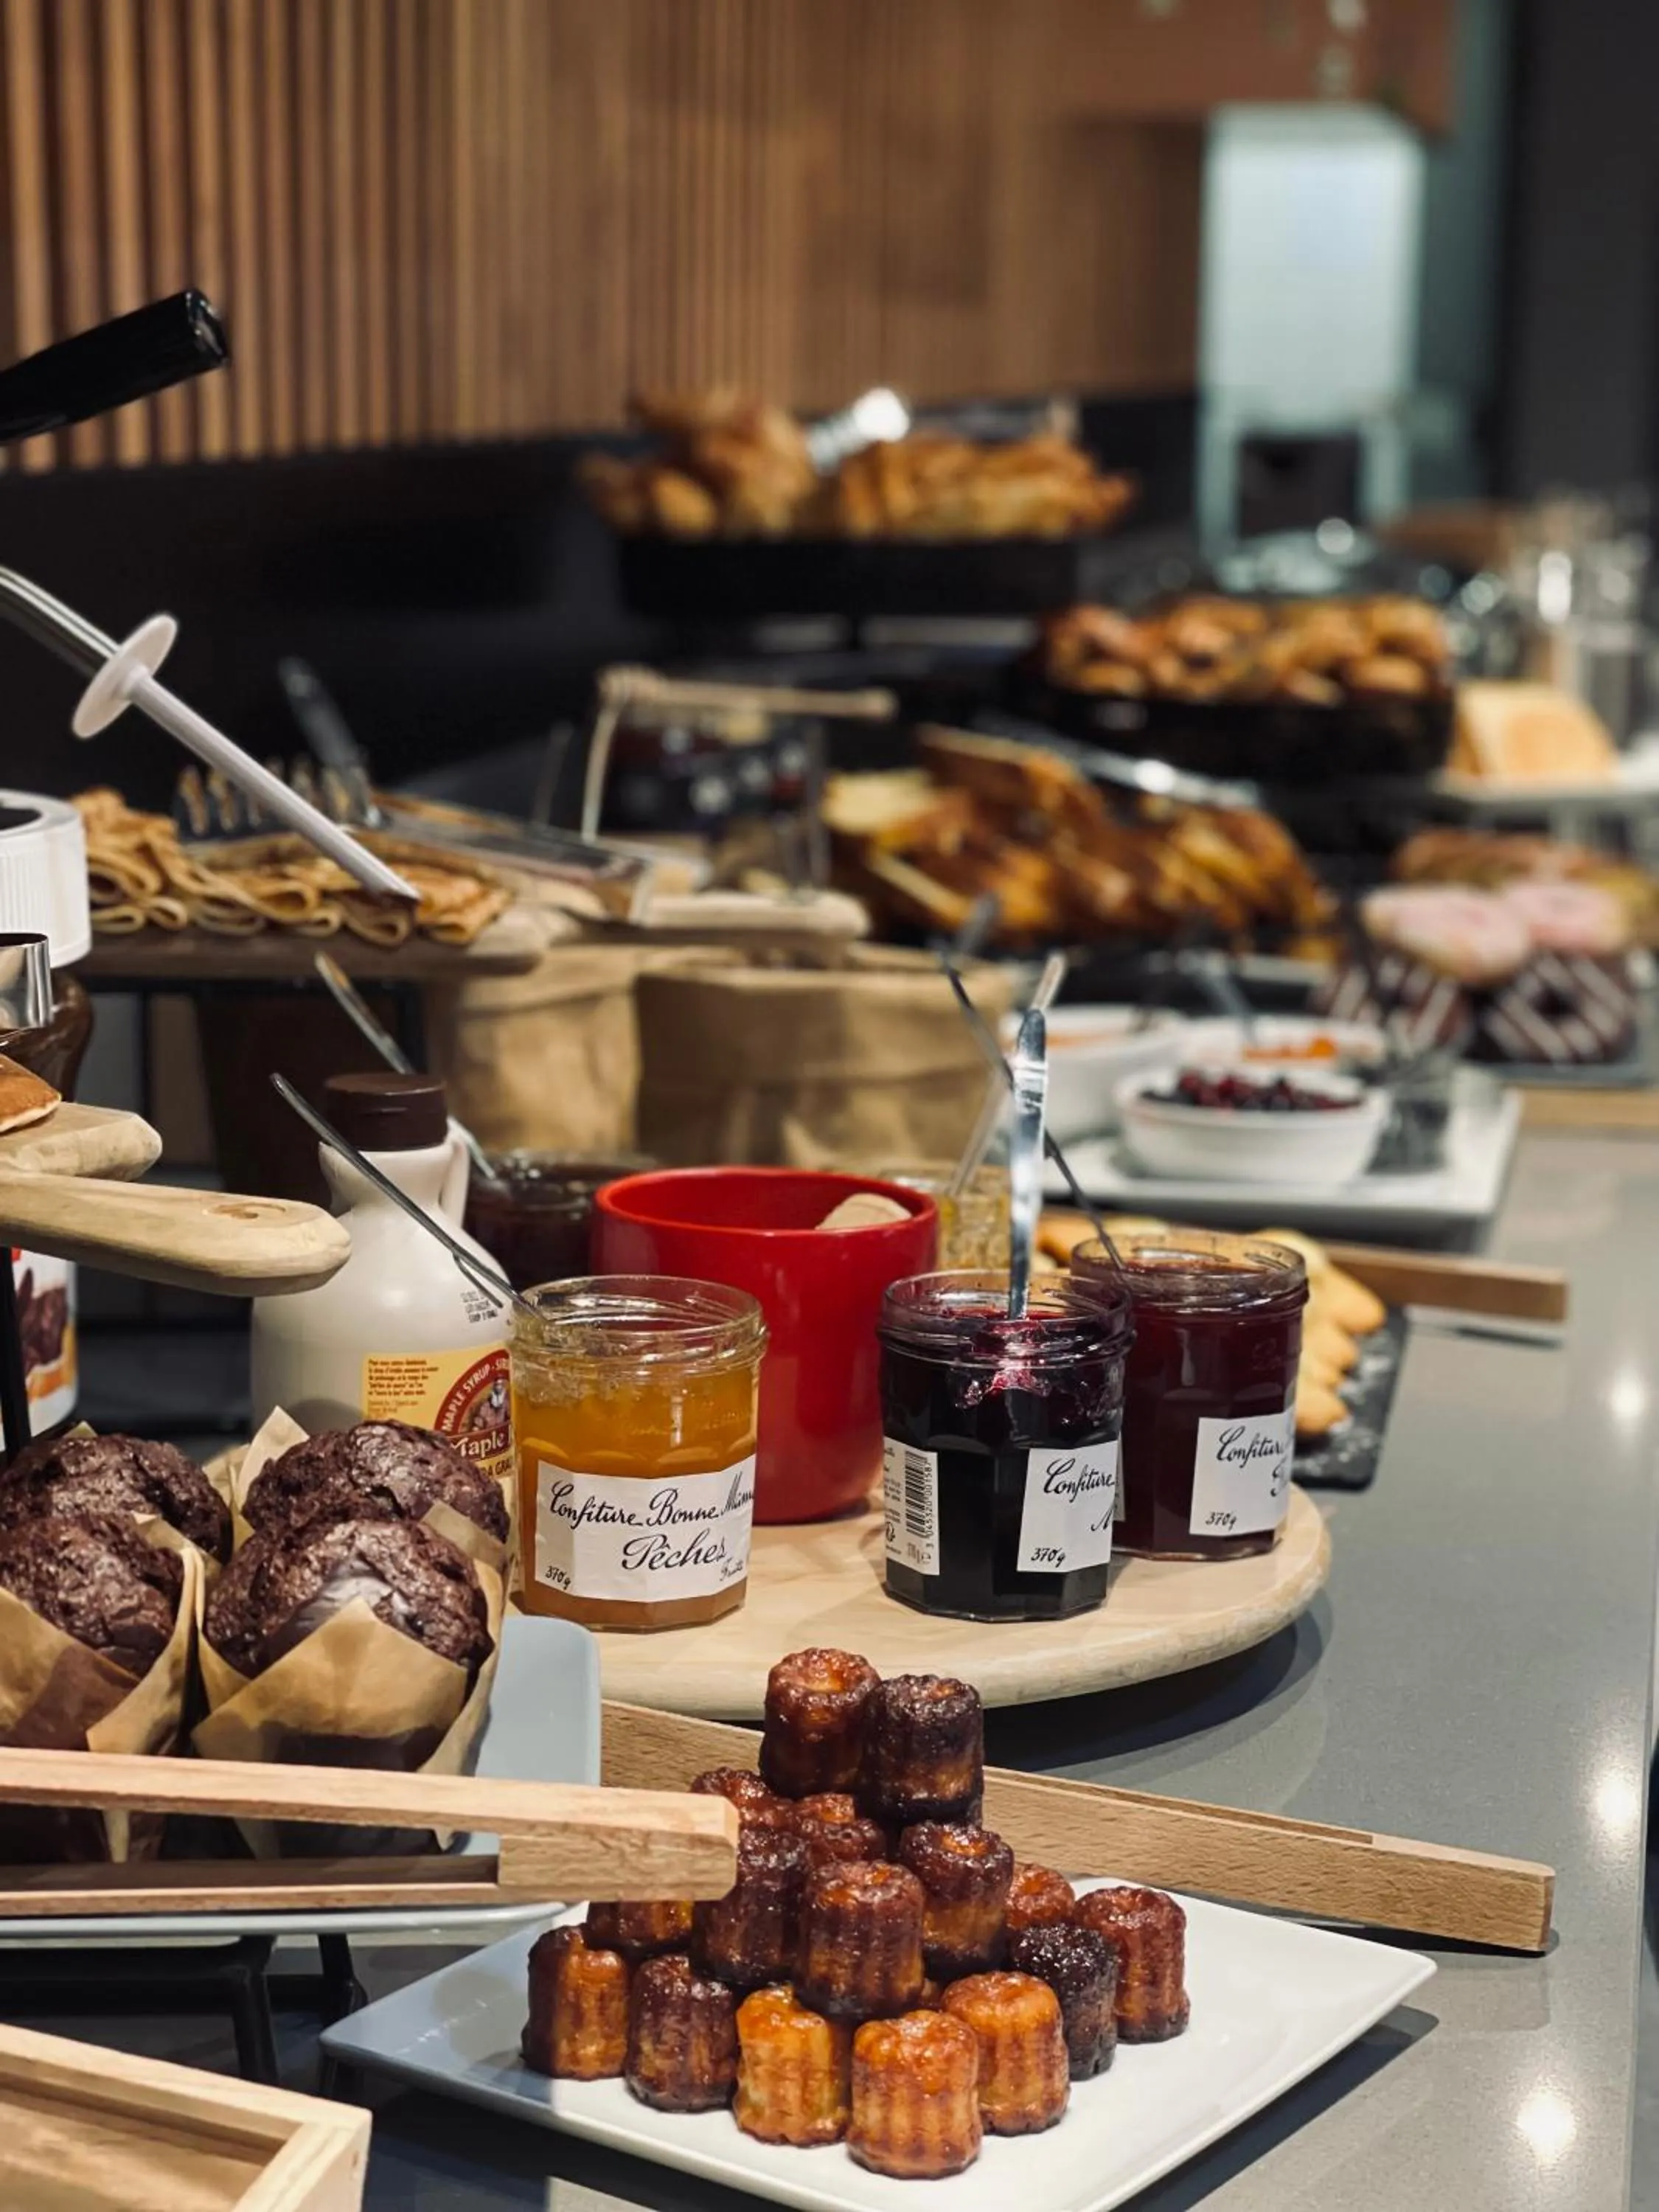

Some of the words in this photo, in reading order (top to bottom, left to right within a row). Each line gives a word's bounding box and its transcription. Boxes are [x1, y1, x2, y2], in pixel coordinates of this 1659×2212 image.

[442, 1391, 465, 1432] MAPLE
[462, 1363, 491, 1393] SYRUP
[1216, 1425, 1284, 1469] Confitur
[1043, 1458, 1116, 1503] Confiture
[549, 1481, 642, 1530] Confiture
[647, 1486, 719, 1526] Bonne
[621, 1528, 726, 1571] Pêches
